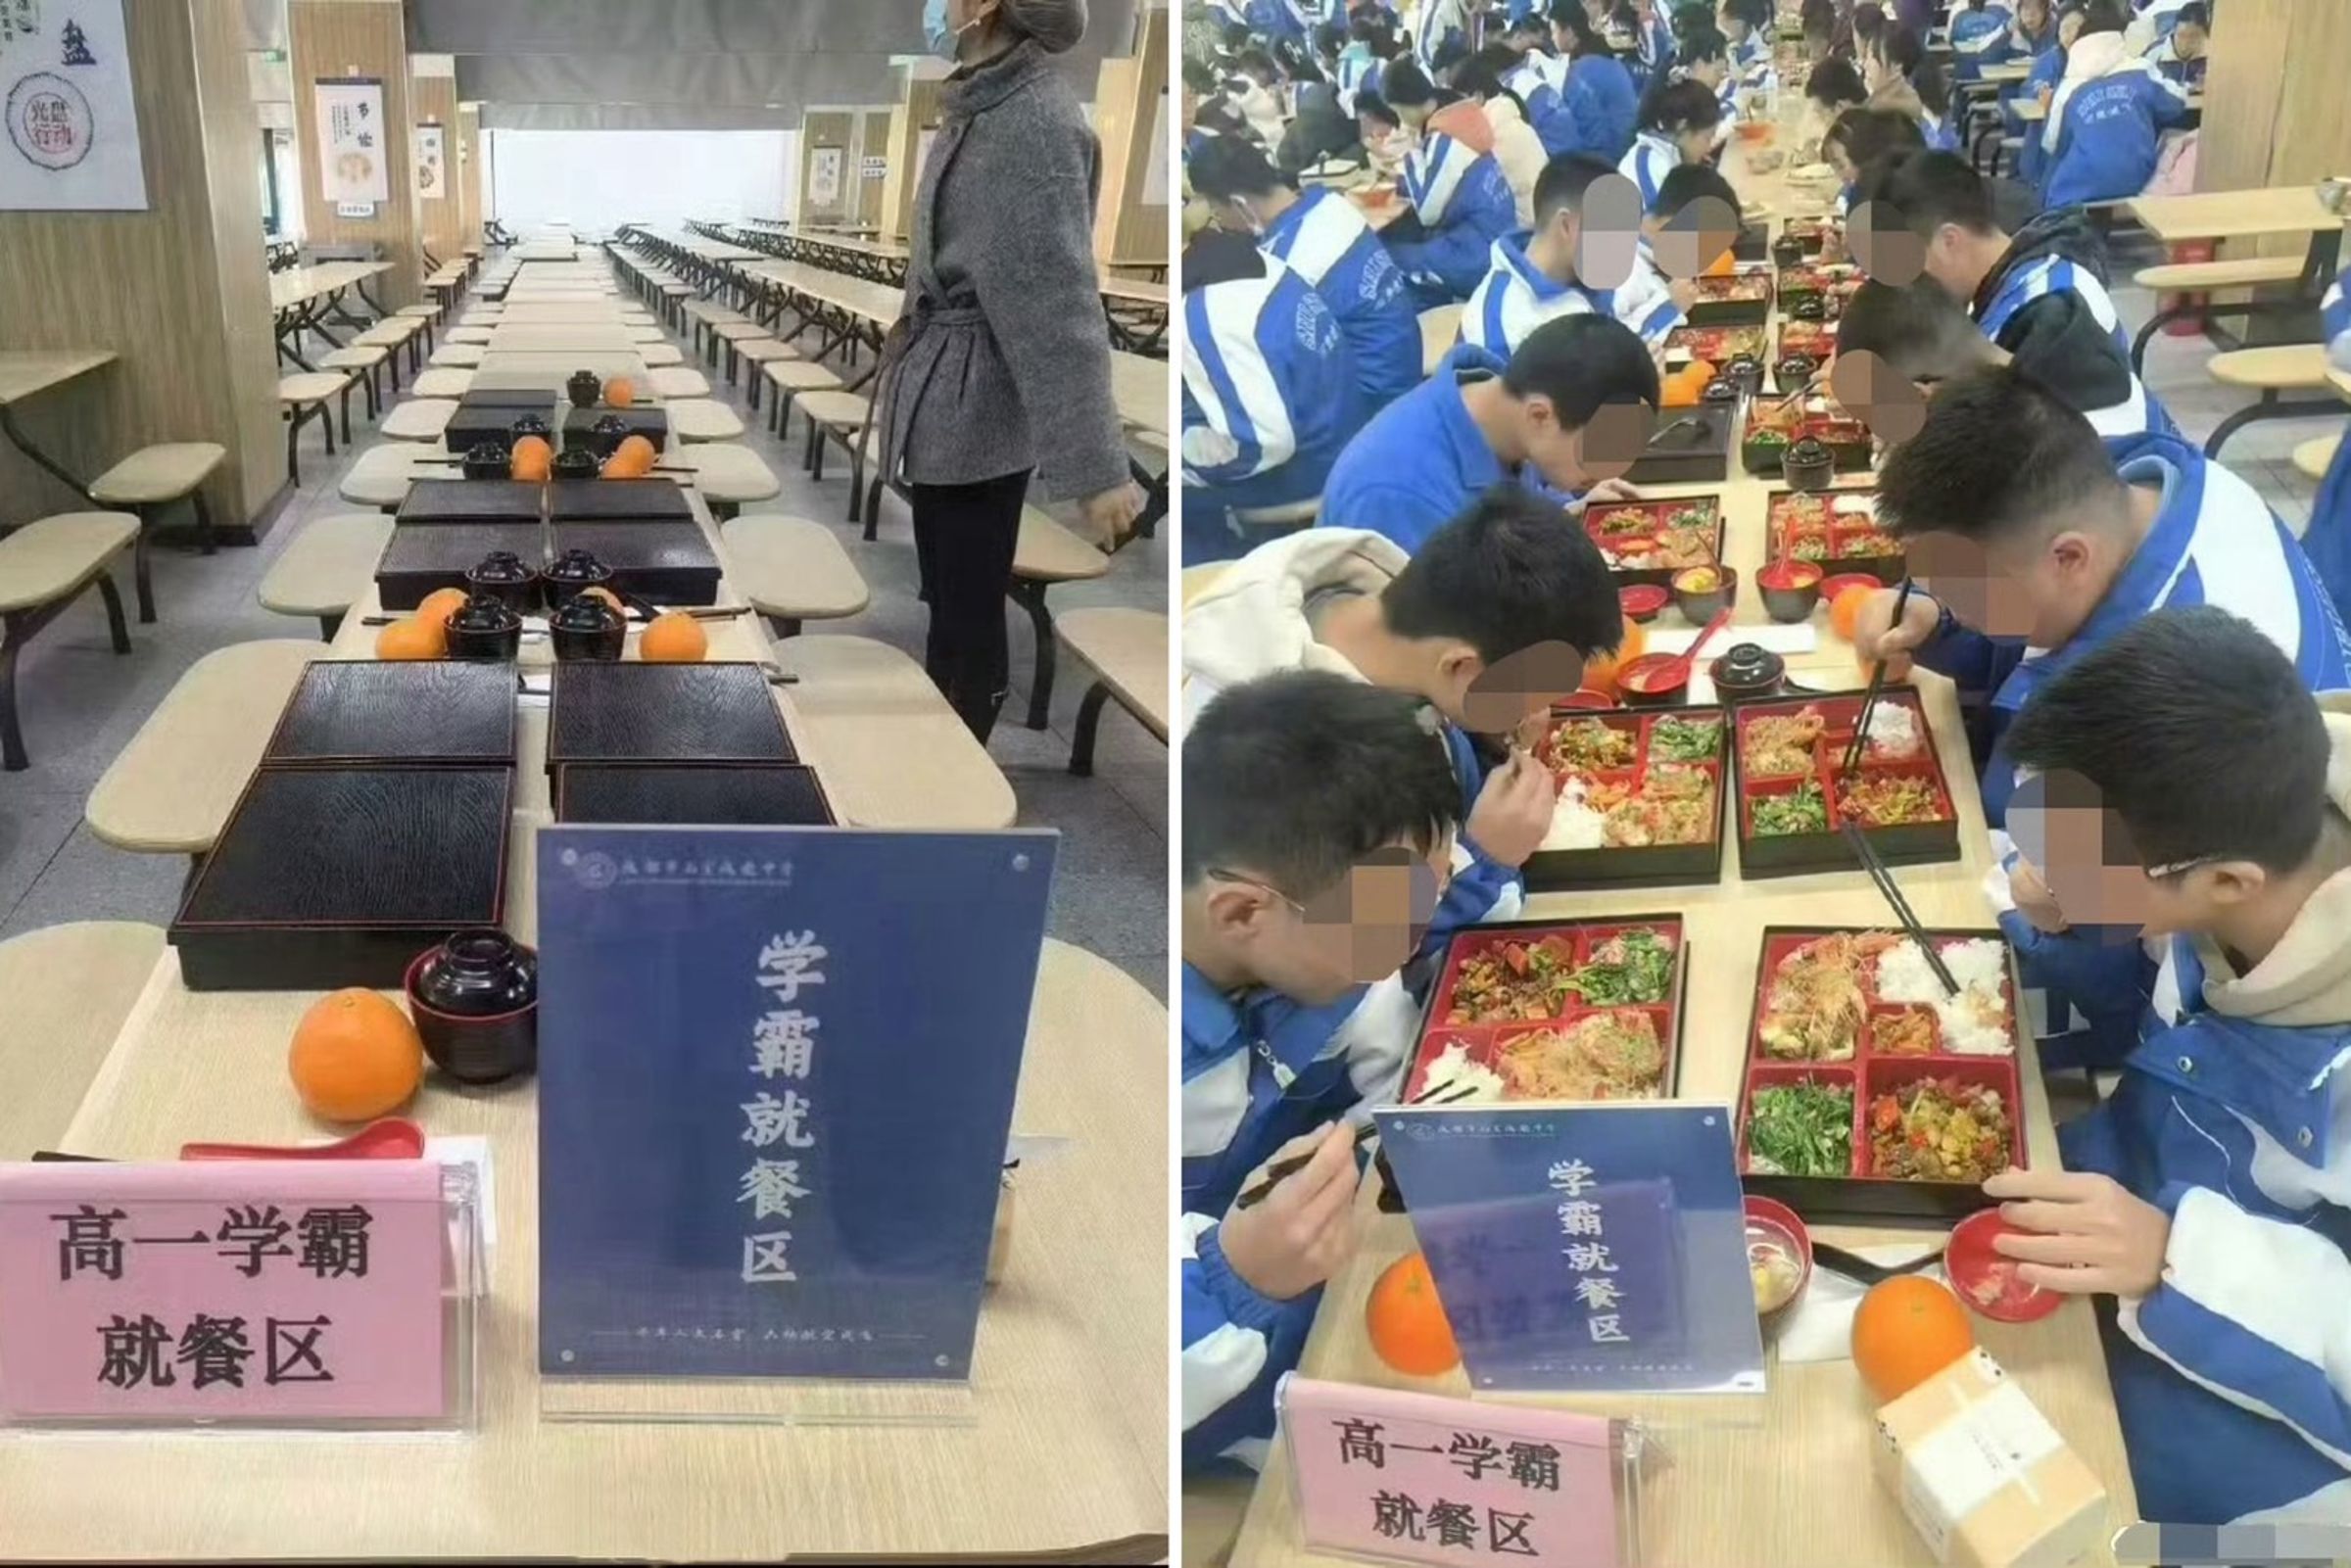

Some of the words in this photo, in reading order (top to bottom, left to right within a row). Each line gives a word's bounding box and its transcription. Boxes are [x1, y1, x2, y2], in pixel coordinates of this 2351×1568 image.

[736, 929, 829, 1284] 学霸就餐区
[49, 1204, 374, 1281] 高一学霸
[1547, 1158, 1631, 1343] 学霸就餐区
[96, 1313, 335, 1390] 就餐区
[1331, 1417, 1561, 1492] 高一学霸
[1369, 1489, 1540, 1556] 就餐区
